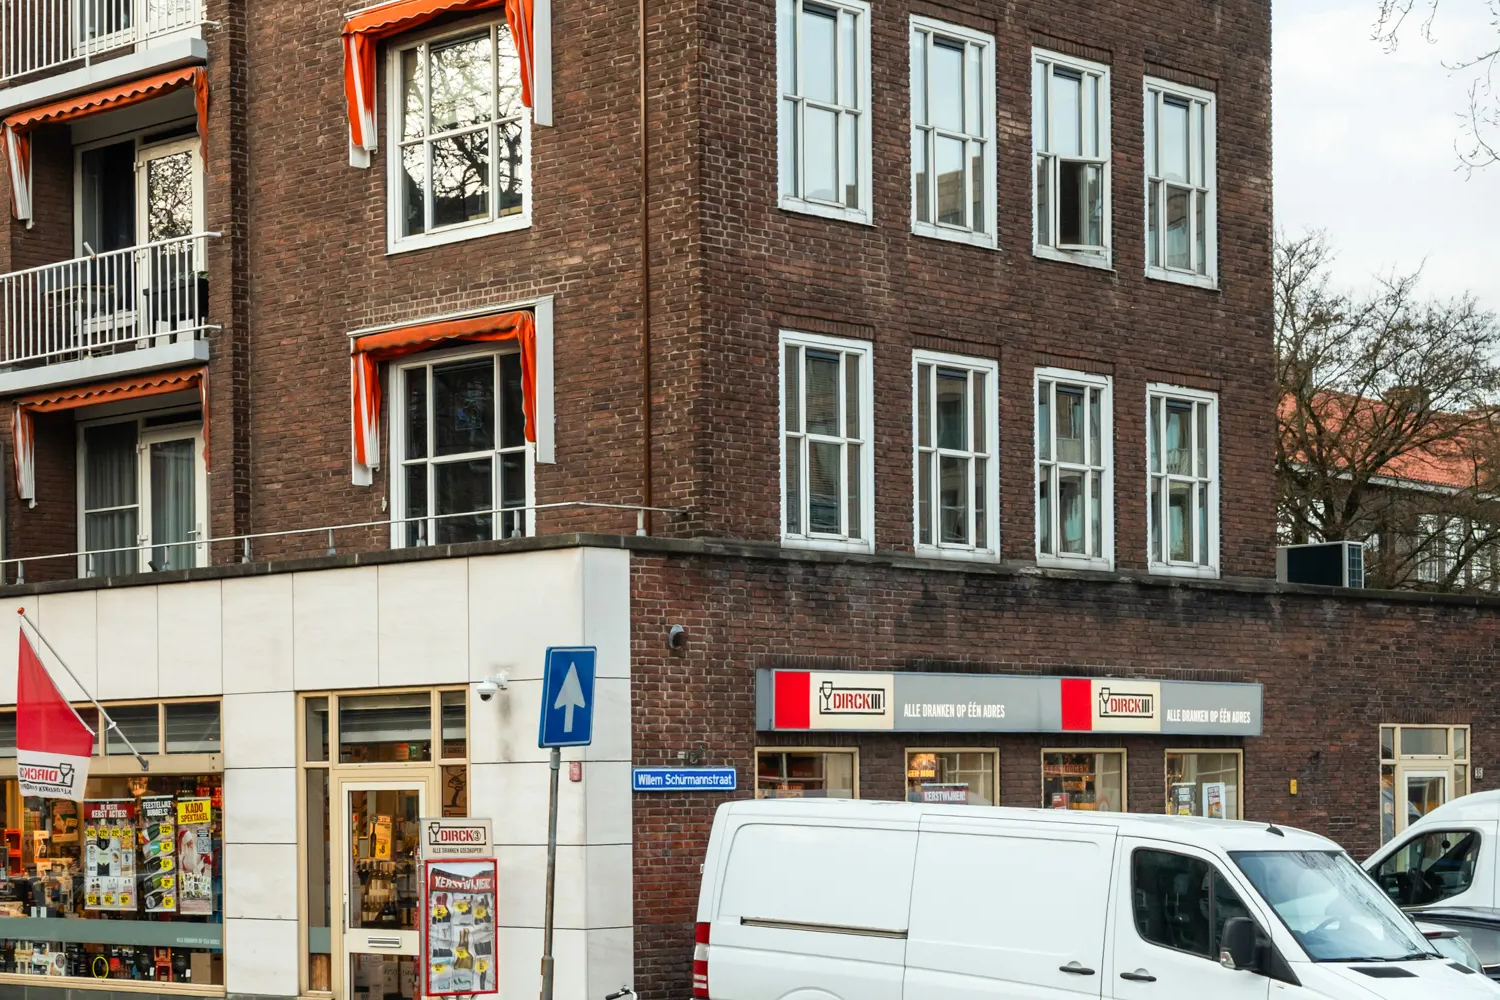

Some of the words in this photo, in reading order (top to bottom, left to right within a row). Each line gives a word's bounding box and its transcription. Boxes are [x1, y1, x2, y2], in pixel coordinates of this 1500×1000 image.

[903, 703, 921, 718] ALLE
[922, 703, 955, 718] DRANKEN
[956, 703, 967, 718] OP
[967, 701, 982, 718] ÉÉN
[982, 704, 1005, 718] ADRES
[1166, 708, 1181, 722] ALLE
[1182, 709, 1209, 723] DRANKEN
[1210, 710, 1219, 723] OP
[1219, 708, 1231, 724] ÉÉN
[1232, 711, 1251, 724] ADRES
[637, 773, 663, 786] Willem
[665, 773, 732, 786] Schürmannstraat
[184, 802, 204, 814] KADO
[180, 812, 209, 823] SPEKTAKEL
